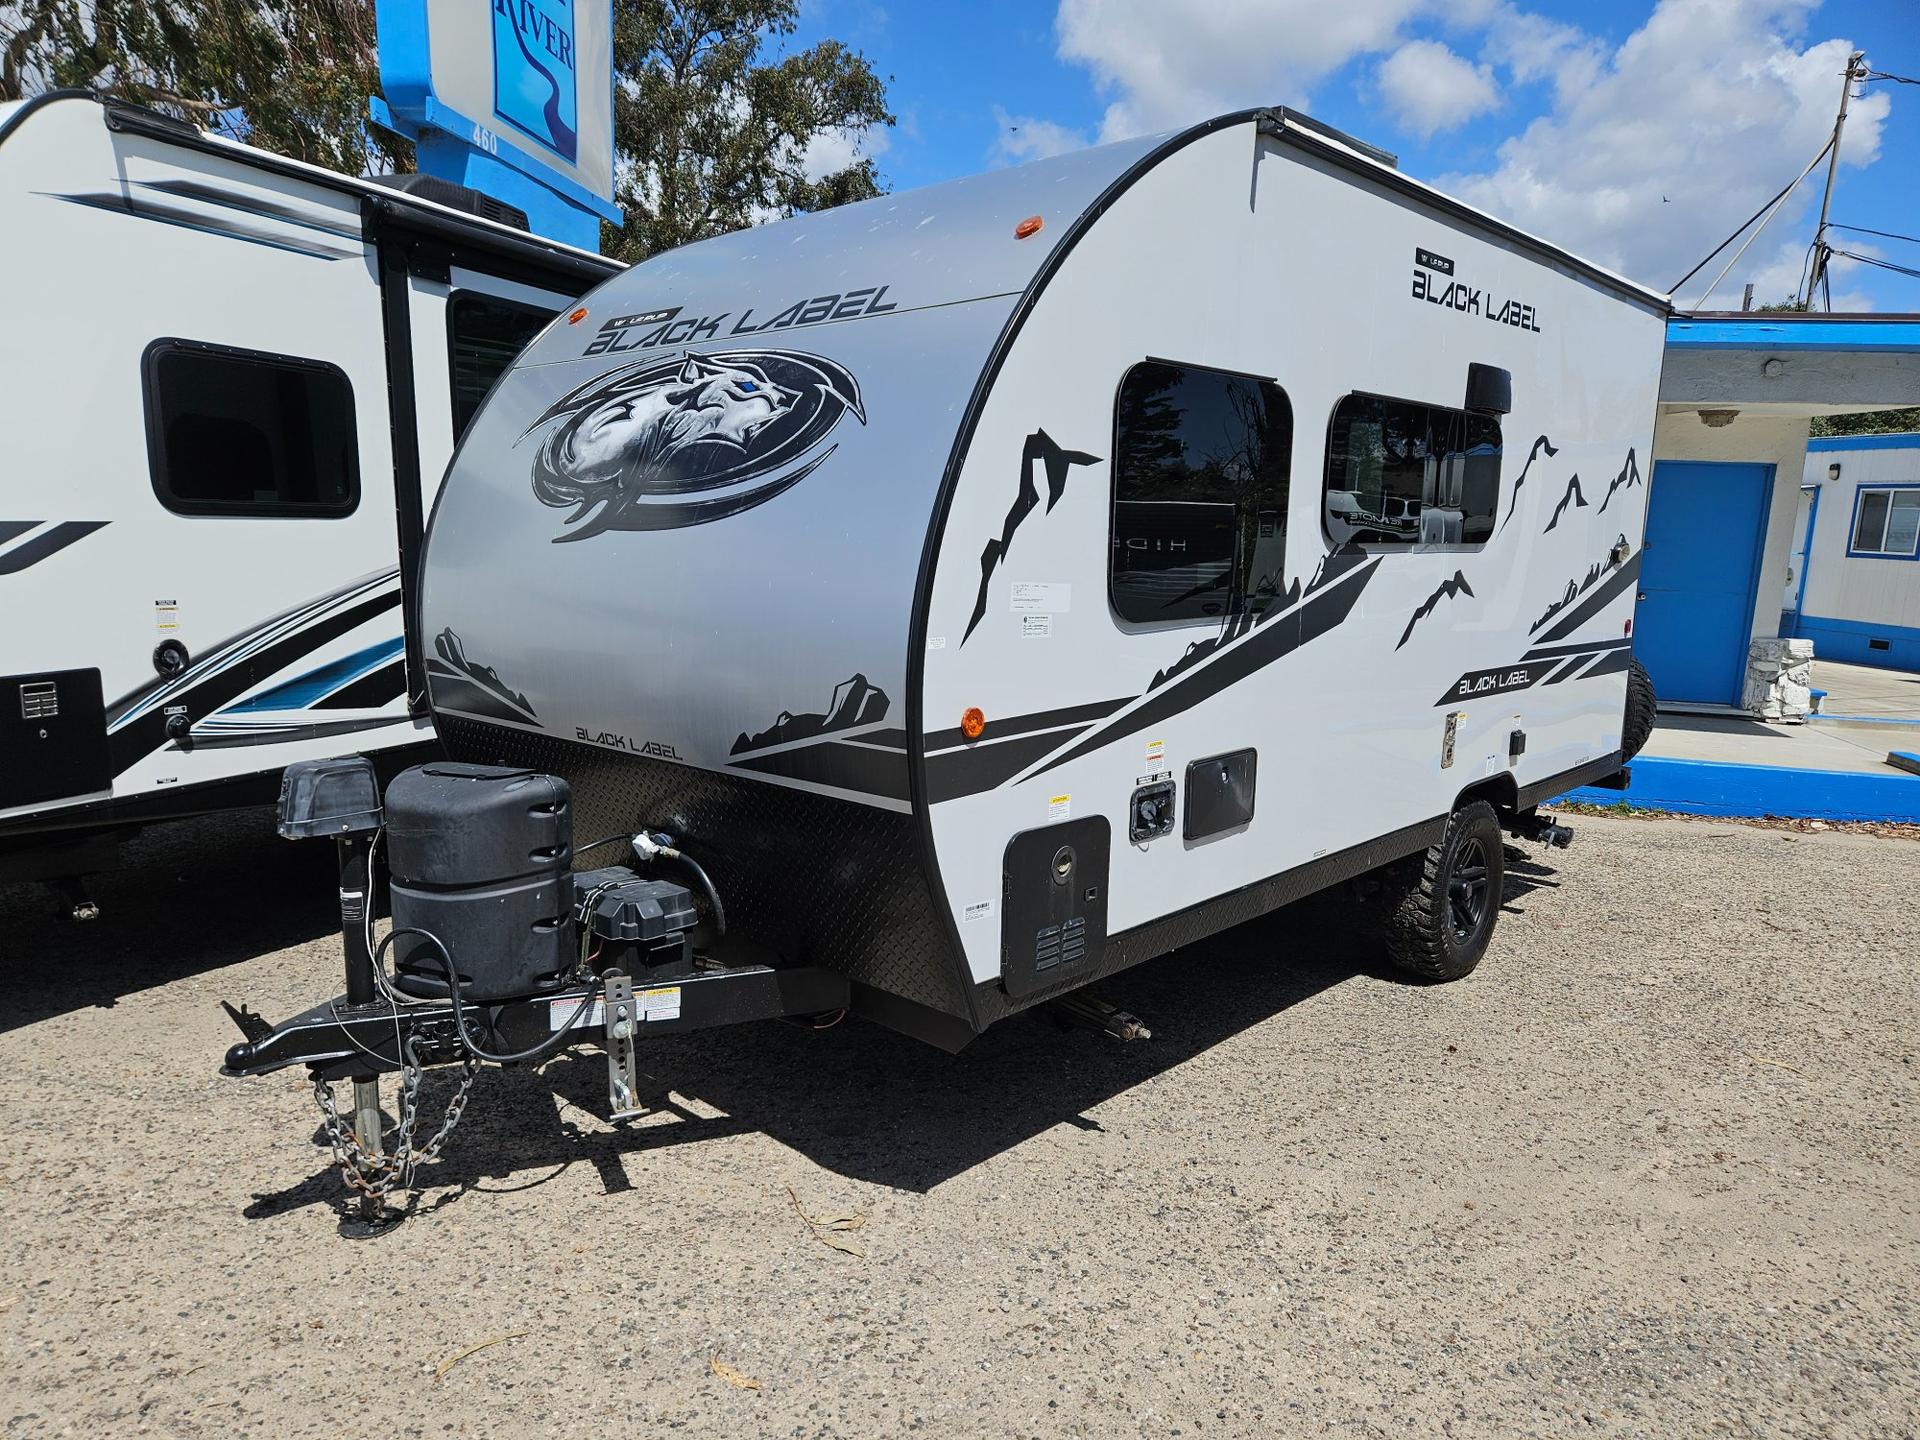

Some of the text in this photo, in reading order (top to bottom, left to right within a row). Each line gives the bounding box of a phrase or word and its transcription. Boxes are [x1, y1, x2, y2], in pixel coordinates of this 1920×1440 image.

[473, 123, 498, 156] 460
[1411, 269, 1541, 334] BLACK LABEL
[582, 285, 898, 357] BLACK LABEL
[1458, 669, 1531, 695] BLACK LABEL
[575, 726, 684, 761] BLACK LABEL
